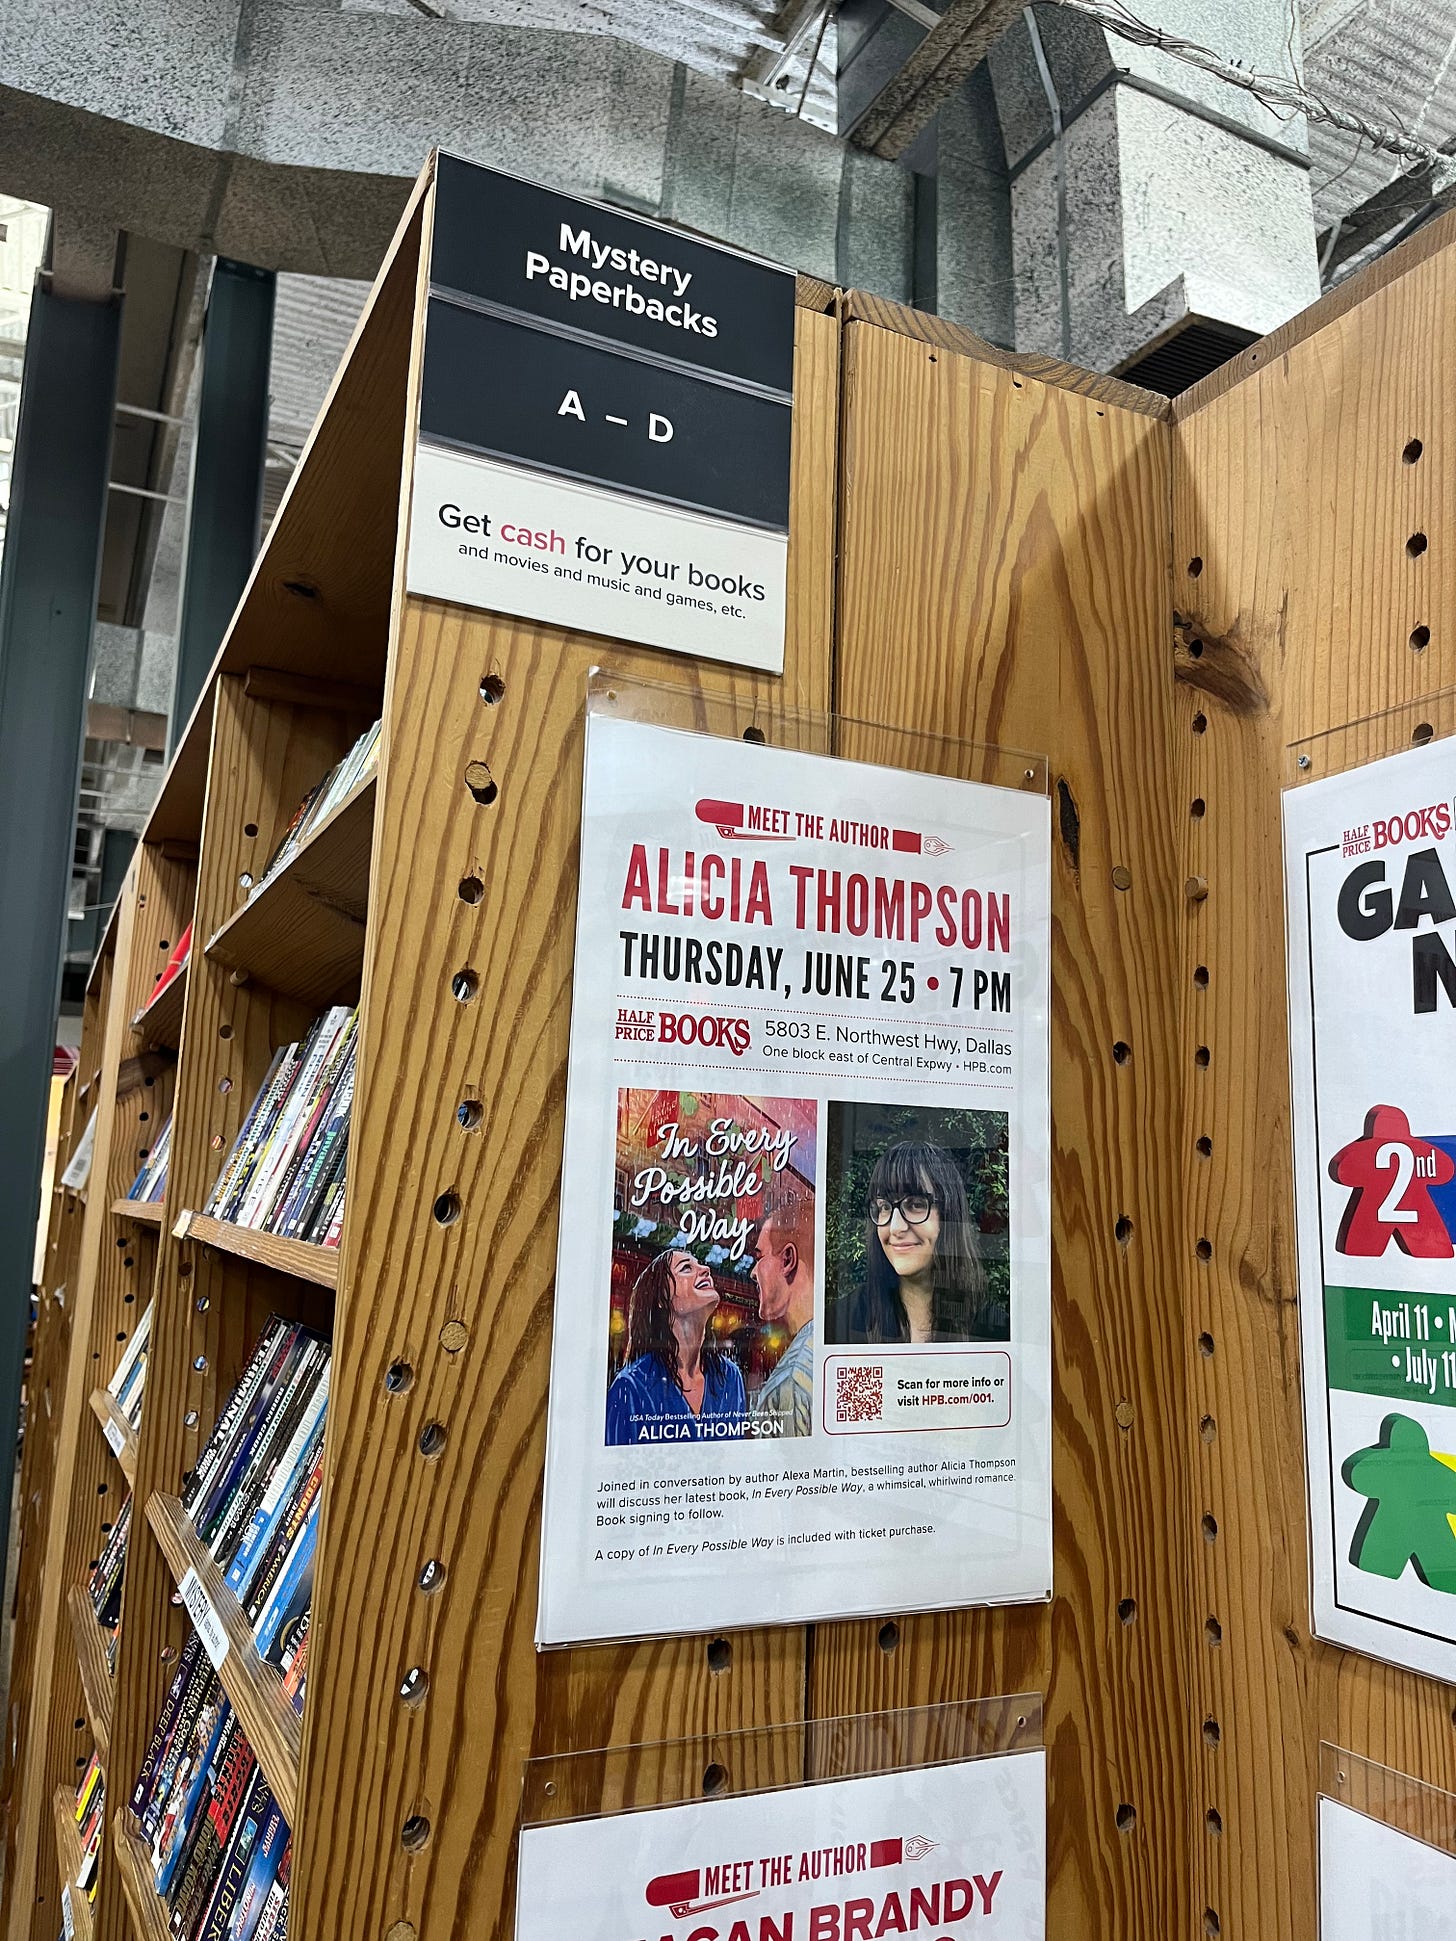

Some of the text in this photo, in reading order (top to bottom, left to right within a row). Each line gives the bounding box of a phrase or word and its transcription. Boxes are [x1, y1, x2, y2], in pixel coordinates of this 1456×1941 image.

[559, 222, 693, 296] Mystery
[526, 250, 719, 338] Paperbacks
[557, 390, 587, 422] A
[648, 413, 675, 443] D
[438, 503, 766, 601] Get cash for your books
[458, 540, 746, 620] and movies and music and games, etc.
[748, 804, 890, 850] MEET THE AUTHOR
[1342, 824, 1370, 843] HALF
[1342, 839, 1371, 858] PRICE
[1372, 802, 1451, 850] BOOKS
[621, 843, 1011, 953] ALICIA THOMPSON
[619, 931, 1012, 1013] THURSDAY, JUNE 25 7 PM
[614, 1026, 656, 1043] PRICE
[617, 1008, 655, 1025] HALF
[657, 1011, 752, 1055] BOOKS
[765, 1019, 1012, 1056] 5803 E. Northwest Hwy, Dallas
[762, 1045, 1012, 1075] One block east of Central Expwy HPB.com
[658, 1118, 798, 1171] In Every
[631, 1159, 763, 1207] Possible
[680, 1209, 755, 1260] Way
[1371, 1300, 1411, 1345] April
[1413, 1305, 1429, 1341] 11
[213, 1336, 275, 1446] TERMINAL
[897, 1376, 1005, 1391] Scan for more info or
[1406, 1346, 1437, 1395] July
[629, 1414, 644, 1422] USA
[644, 1414, 665, 1422] Today
[665, 1412, 701, 1421] Bestselling
[702, 1411, 724, 1419] Author
[732, 1410, 751, 1418] Never
[897, 1392, 995, 1407] visit HPB.com/001.
[638, 1420, 784, 1441] ALICIA THOMPSON
[596, 1497, 615, 1509] will
[617, 1493, 661, 1508] discuss
[663, 1493, 682, 1505] her
[685, 1491, 716, 1504] latest
[718, 1488, 750, 1503] book,
[751, 1488, 762, 1500] In
[763, 1485, 794, 1502] Every
[795, 1481, 838, 1498] Possible
[868, 1483, 874, 1491] a
[928, 1474, 972, 1488] whirlwind
[974, 1472, 1017, 1484] romance.
[597, 1456, 1017, 1494] Joined in conversation by author Alexa Martin, bestselling author Alicia Thompson
[285, 1474, 318, 1541] COONTS
[596, 1508, 725, 1527] Book signing to follow.
[595, 1522, 936, 1563] A copy of In Every Possible Way is included with ticket purchase.
[254, 1553, 282, 1606] AMERICA
[140, 1699, 175, 1782] DEEP BLACK
[705, 1843, 866, 1897] MEET THE AUTHOR
[810, 1870, 1004, 1941] BRANDY
